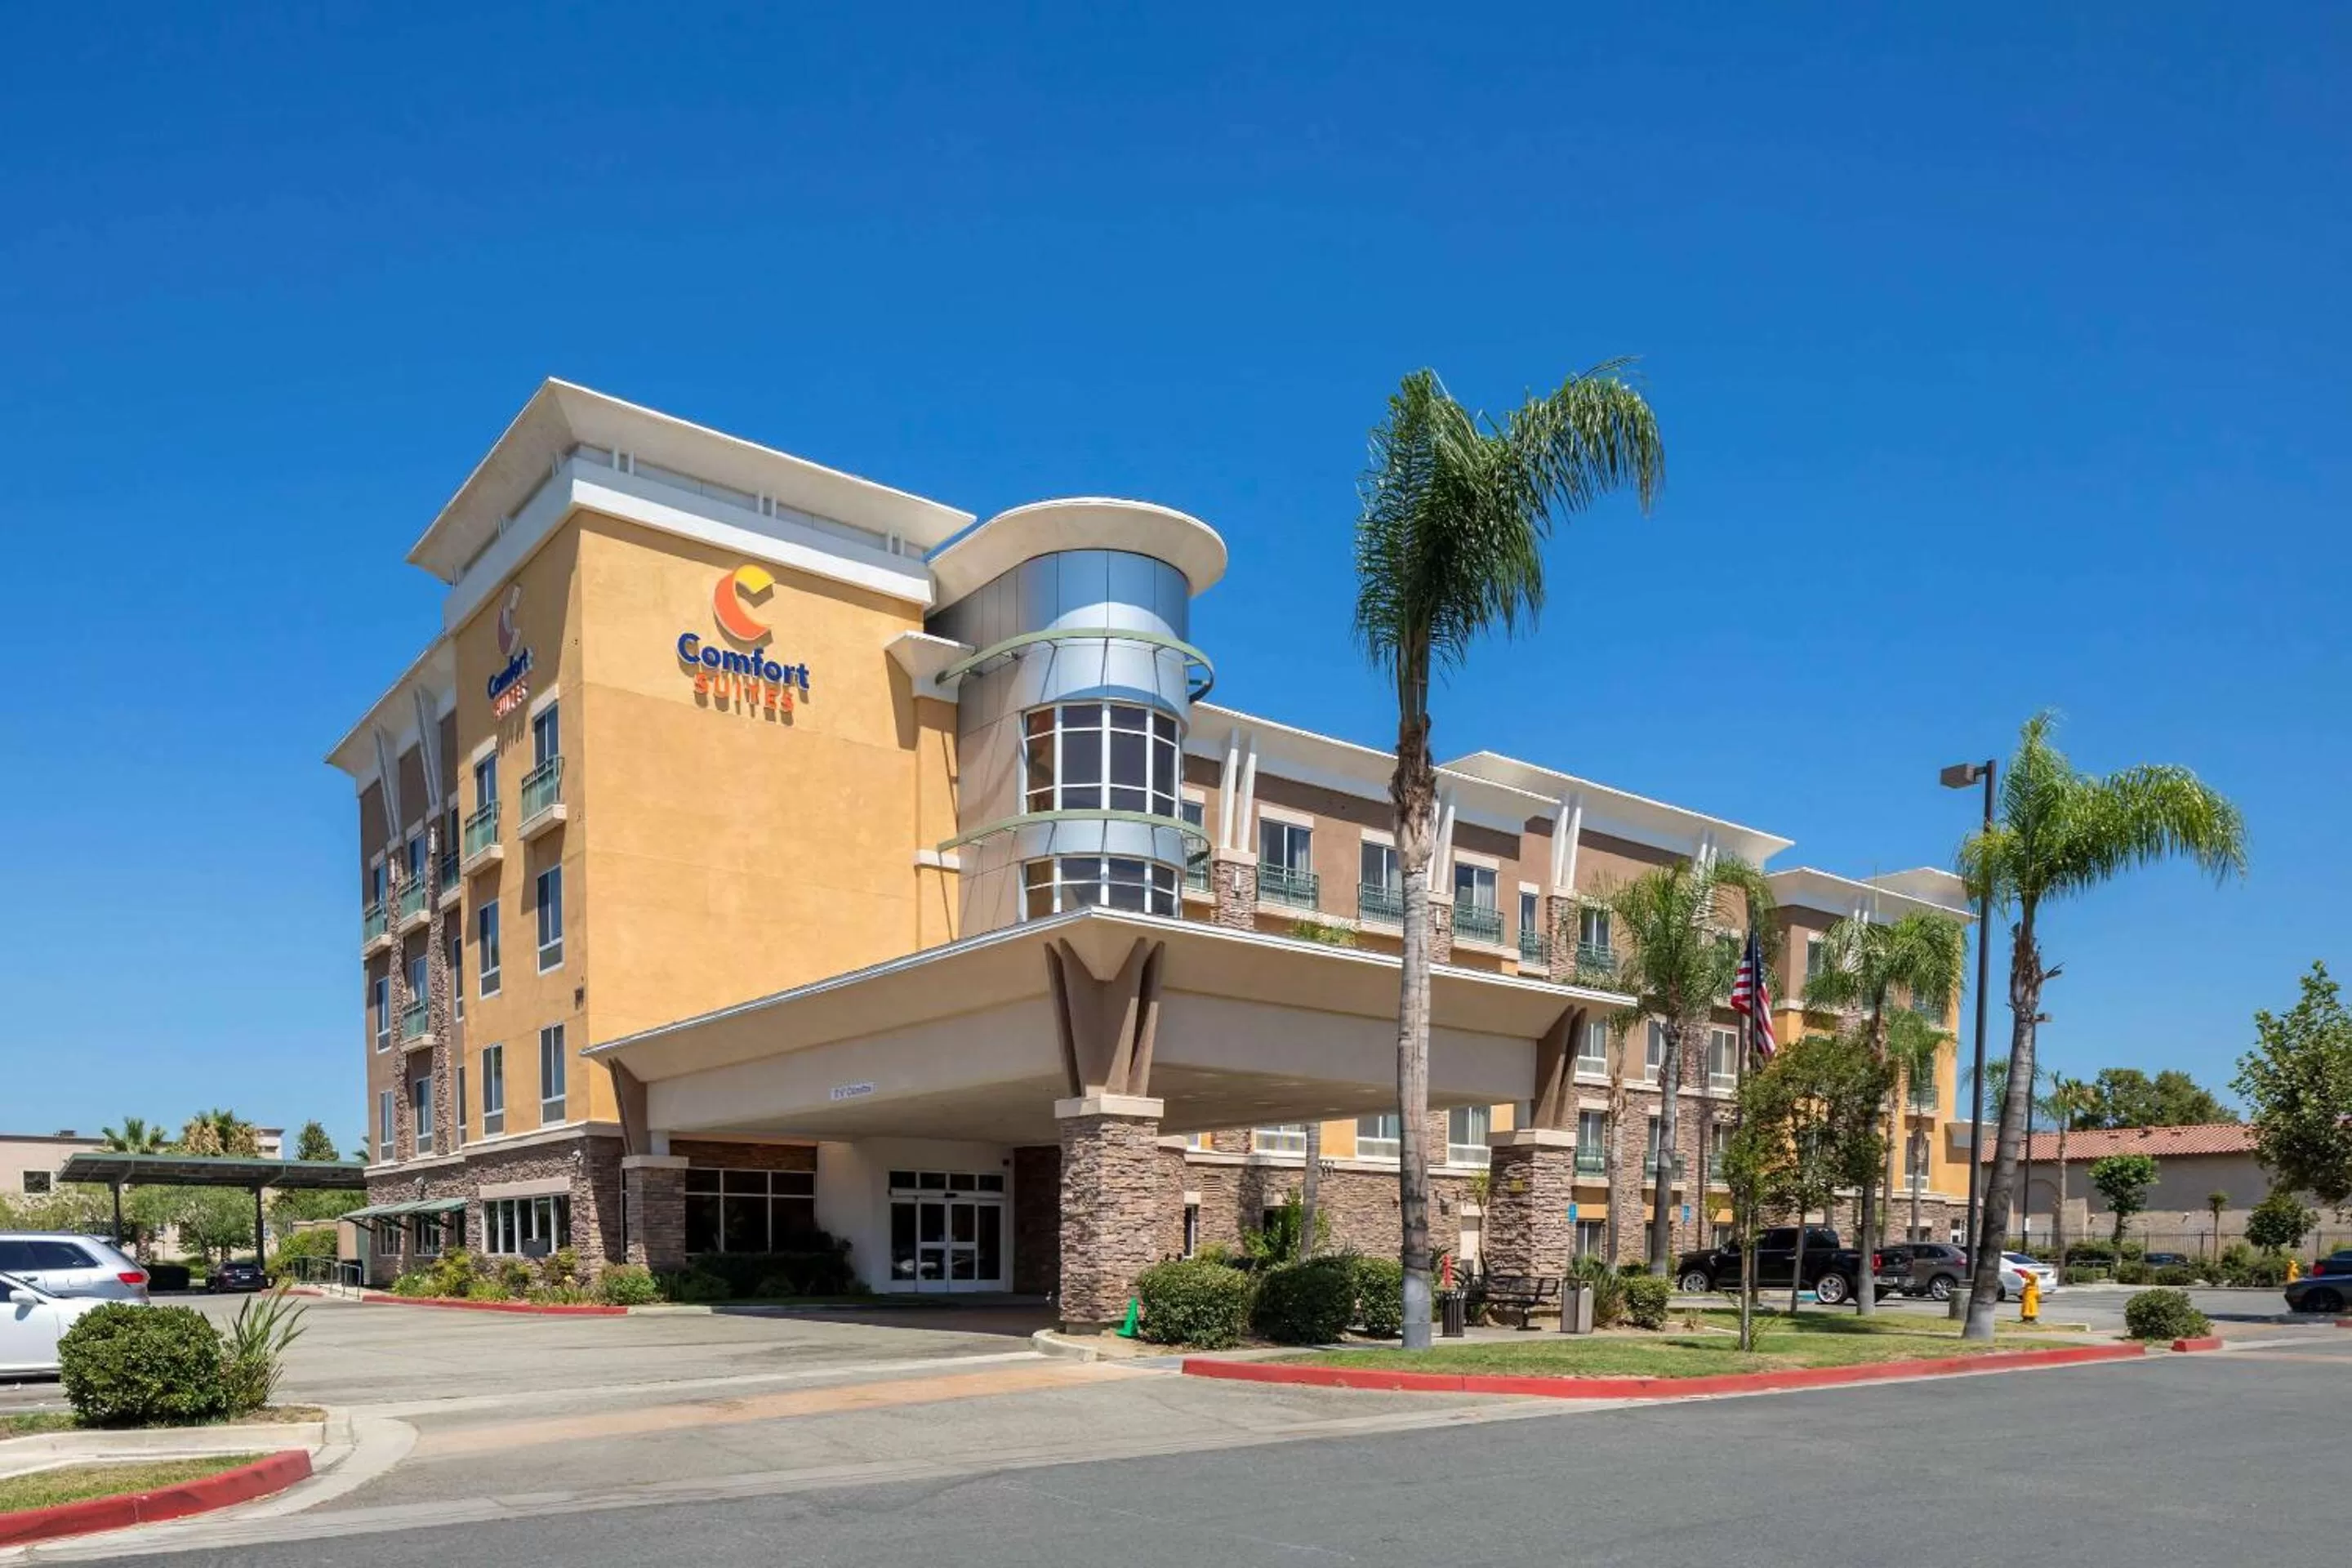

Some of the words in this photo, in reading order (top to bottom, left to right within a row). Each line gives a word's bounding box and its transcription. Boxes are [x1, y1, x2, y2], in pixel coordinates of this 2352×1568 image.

[488, 646, 533, 700] Comfort
[677, 632, 810, 691] Comfort
[694, 671, 794, 712] SUITES
